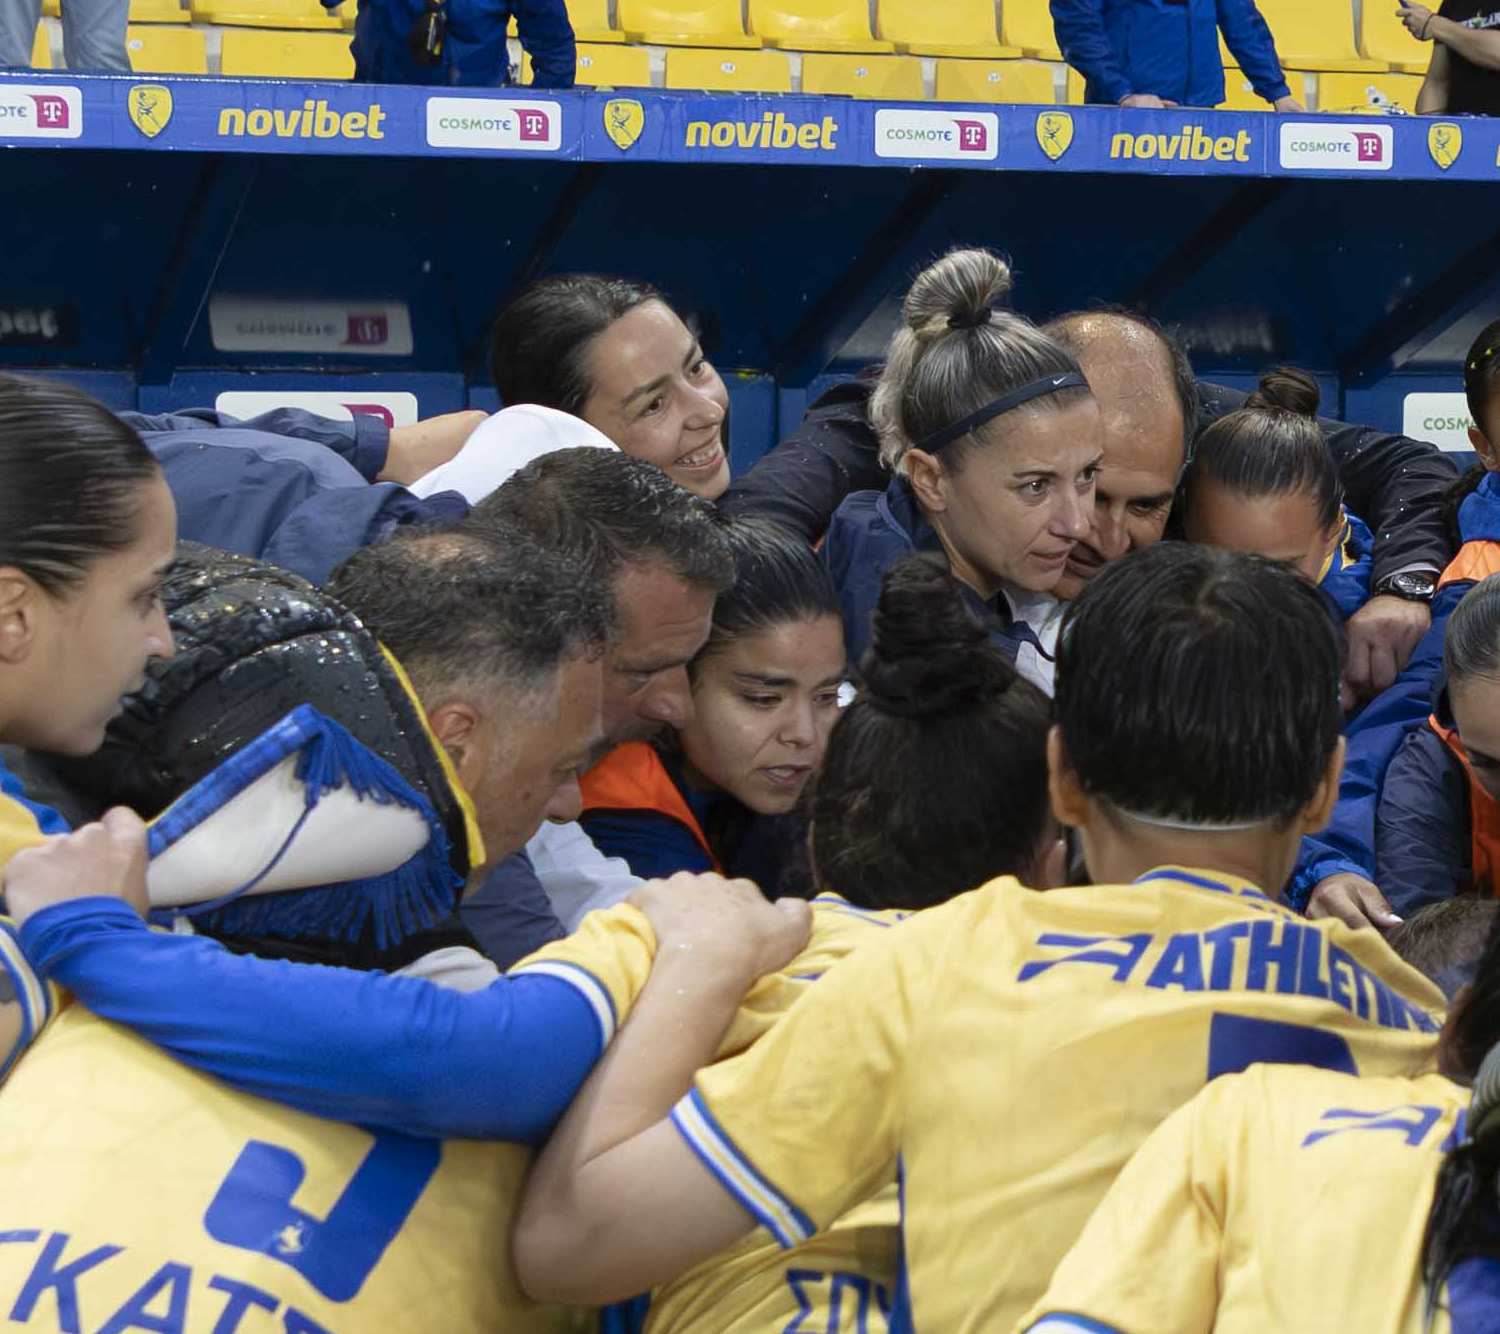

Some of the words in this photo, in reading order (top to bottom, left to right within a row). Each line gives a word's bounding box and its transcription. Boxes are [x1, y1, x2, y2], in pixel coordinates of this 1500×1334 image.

[218, 100, 385, 139] novibet
[439, 117, 512, 132] COSMOTE
[686, 111, 837, 149] novibet
[886, 128, 953, 142] COSMOTE
[1110, 125, 1250, 162] novibet
[1290, 141, 1351, 154] COSMOTE
